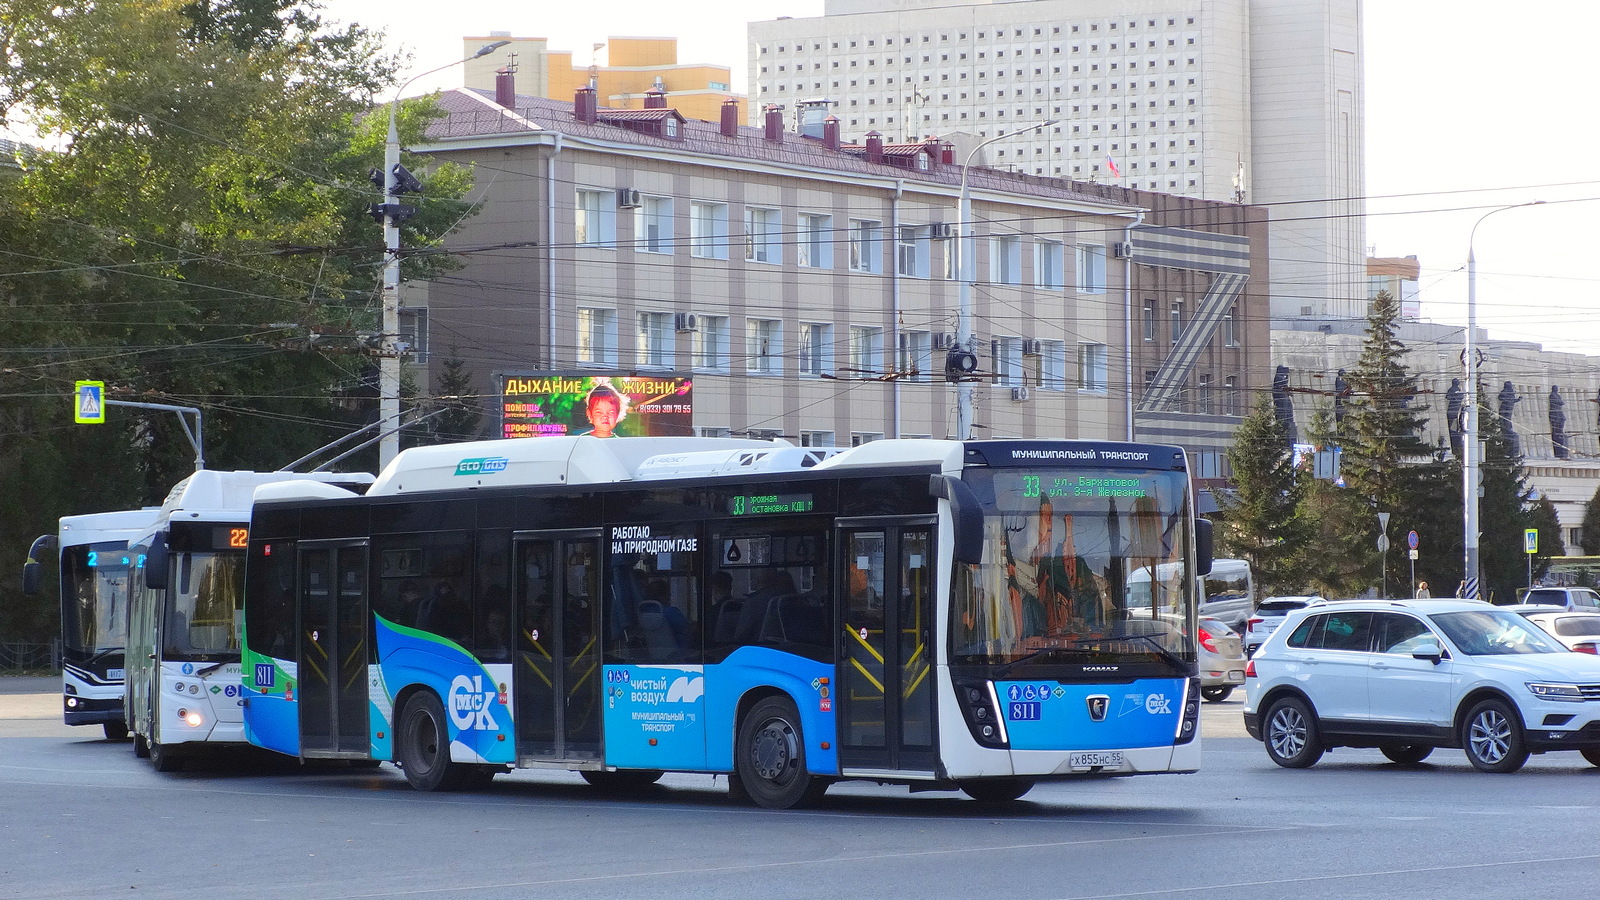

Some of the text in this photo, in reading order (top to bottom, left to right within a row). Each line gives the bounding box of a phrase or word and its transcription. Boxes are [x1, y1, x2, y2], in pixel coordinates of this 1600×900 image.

[505, 379, 675, 396] ДЫХАНИЕ ЖИЗНИ
[504, 404, 540, 412] ПОМОЩЬ
[662, 404, 673, 413] 301
[674, 404, 682, 413] 79
[682, 404, 692, 413] 55
[504, 423, 568, 432] ПРОФИЛАКТИКА
[1011, 449, 1149, 461] МУНИЦИПАЛЬНЫЙ ТРАНСПОРТ
[1022, 475, 1040, 498] 33
[1054, 476, 1140, 488] ул. Бархатовой
[1049, 487, 1068, 498] ул.
[733, 495, 745, 516] 33
[751, 504, 789, 513] остановка
[230, 529, 248, 547] 22
[612, 525, 650, 540] РАБОТАЮ
[611, 538, 698, 555] НА ПРИРОДНОМ ГАЗЕ
[87, 550, 98, 567] 2
[257, 666, 271, 685] 811
[631, 711, 685, 721] МУНИЦИПАЛЬНЫЙ
[1013, 703, 1035, 719] 811
[641, 723, 675, 732] ТРАНСПОРТ
